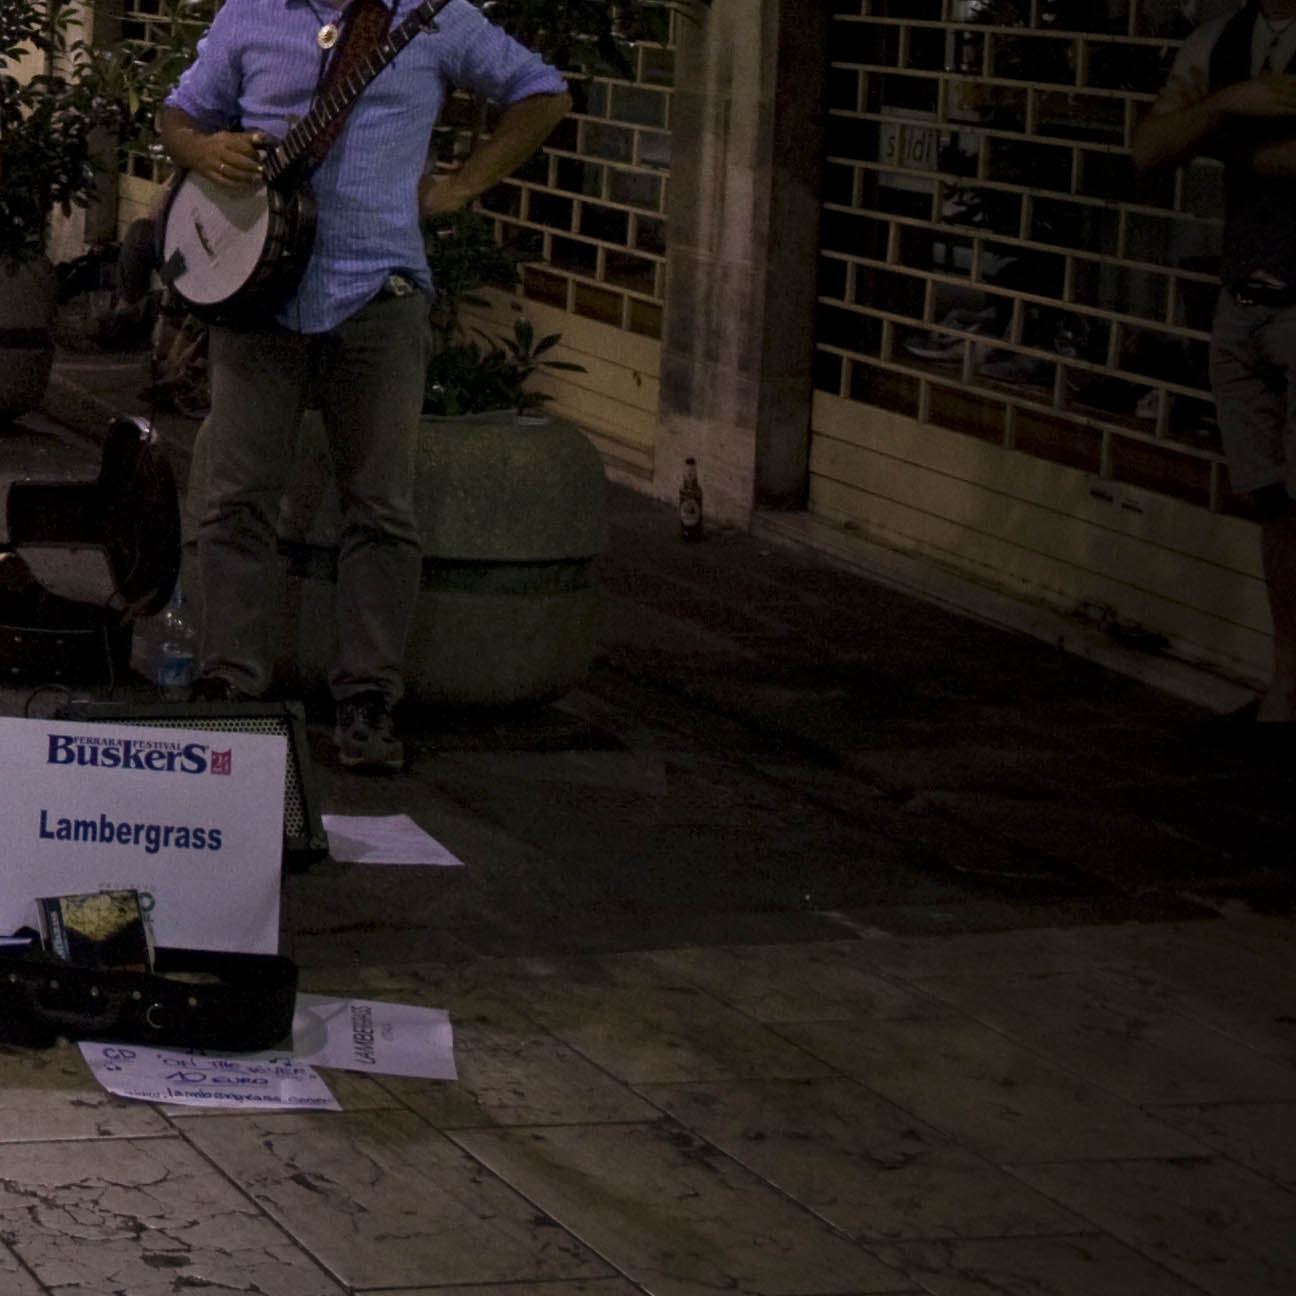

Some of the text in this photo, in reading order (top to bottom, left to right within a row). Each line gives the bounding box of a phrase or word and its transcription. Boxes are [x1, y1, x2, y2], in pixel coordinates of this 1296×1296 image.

[74, 735, 184, 751] FERRARA FESTIVAL
[39, 809, 223, 854] Lambergrass
[102, 1047, 136, 1060] CD
[166, 1070, 207, 1082] 10
